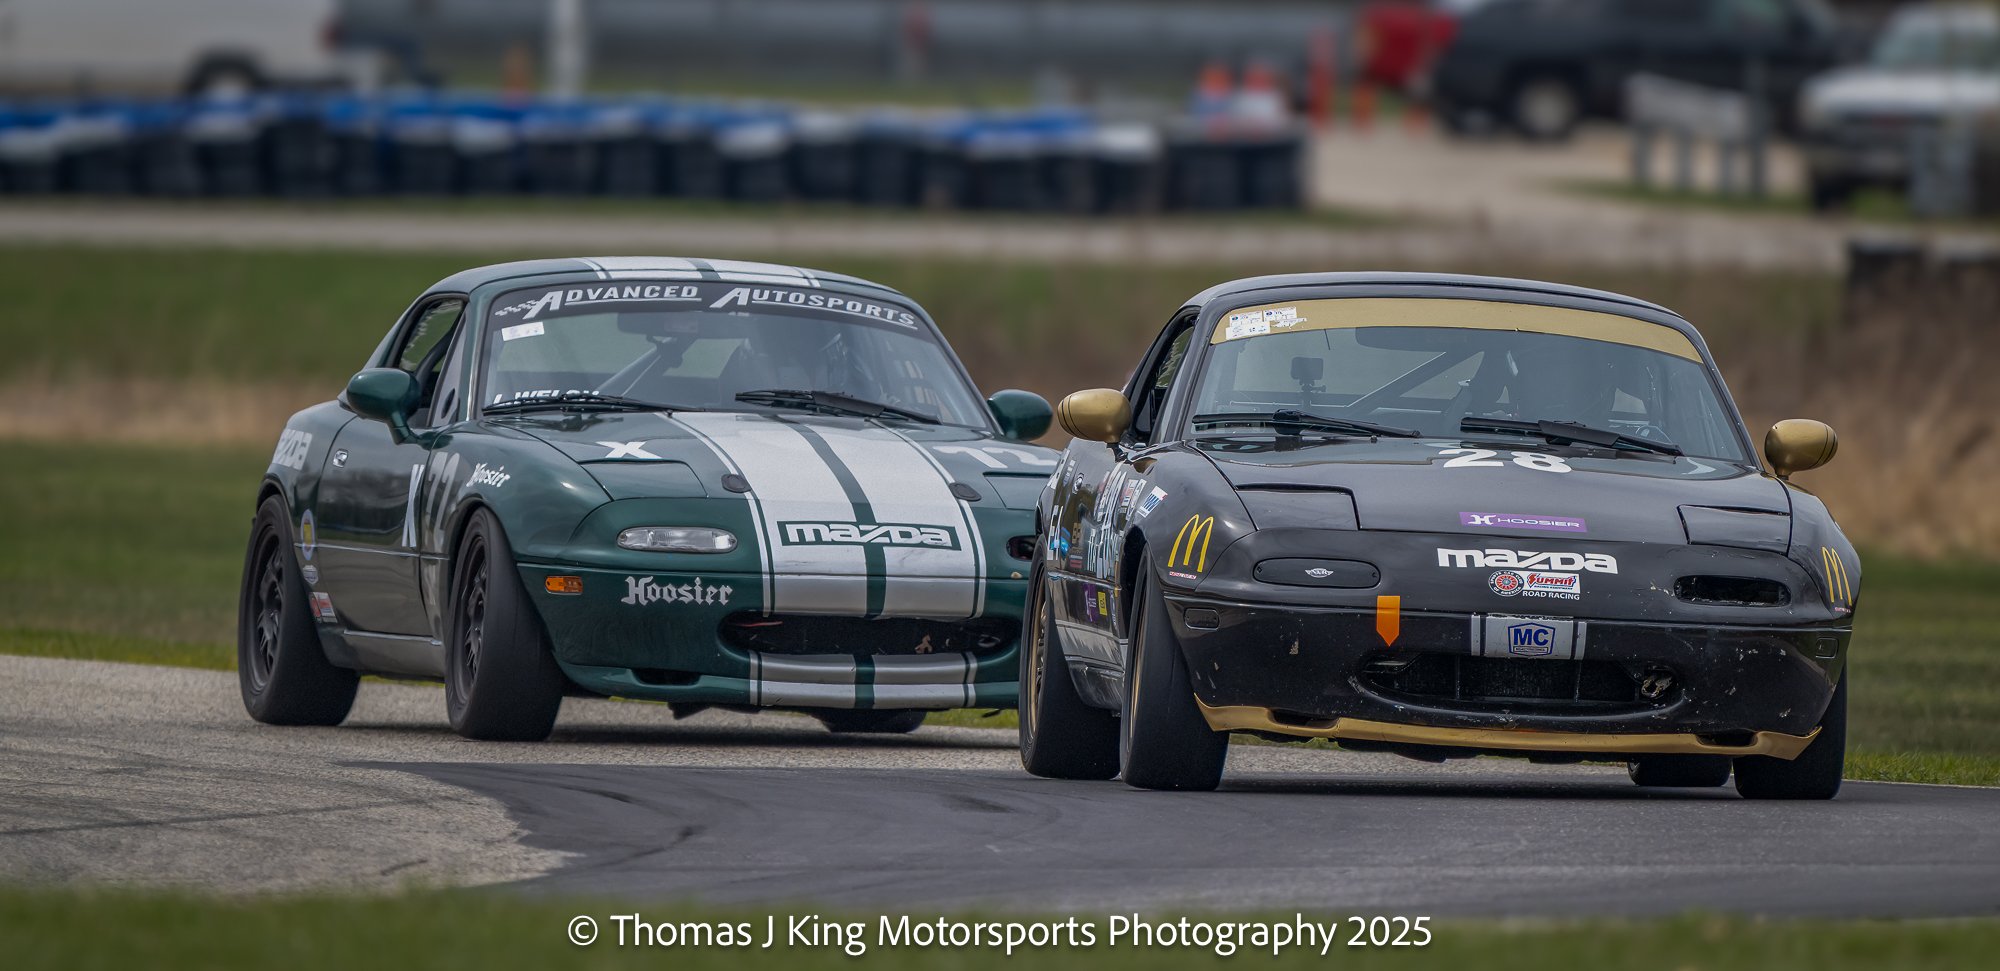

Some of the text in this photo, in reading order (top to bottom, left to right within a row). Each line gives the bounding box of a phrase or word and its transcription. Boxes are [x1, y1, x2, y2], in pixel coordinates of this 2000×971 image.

[522, 285, 917, 326] ADVANCED AUTOSPORTS
[595, 440, 662, 460] X
[932, 445, 1058, 469] 72
[1438, 448, 1572, 473] 28
[1497, 517, 1580, 528] HOOSIER
[621, 576, 734, 606] Hoosier
[1522, 590, 1580, 600] ROAD RACING
[1513, 628, 1549, 646] MC
